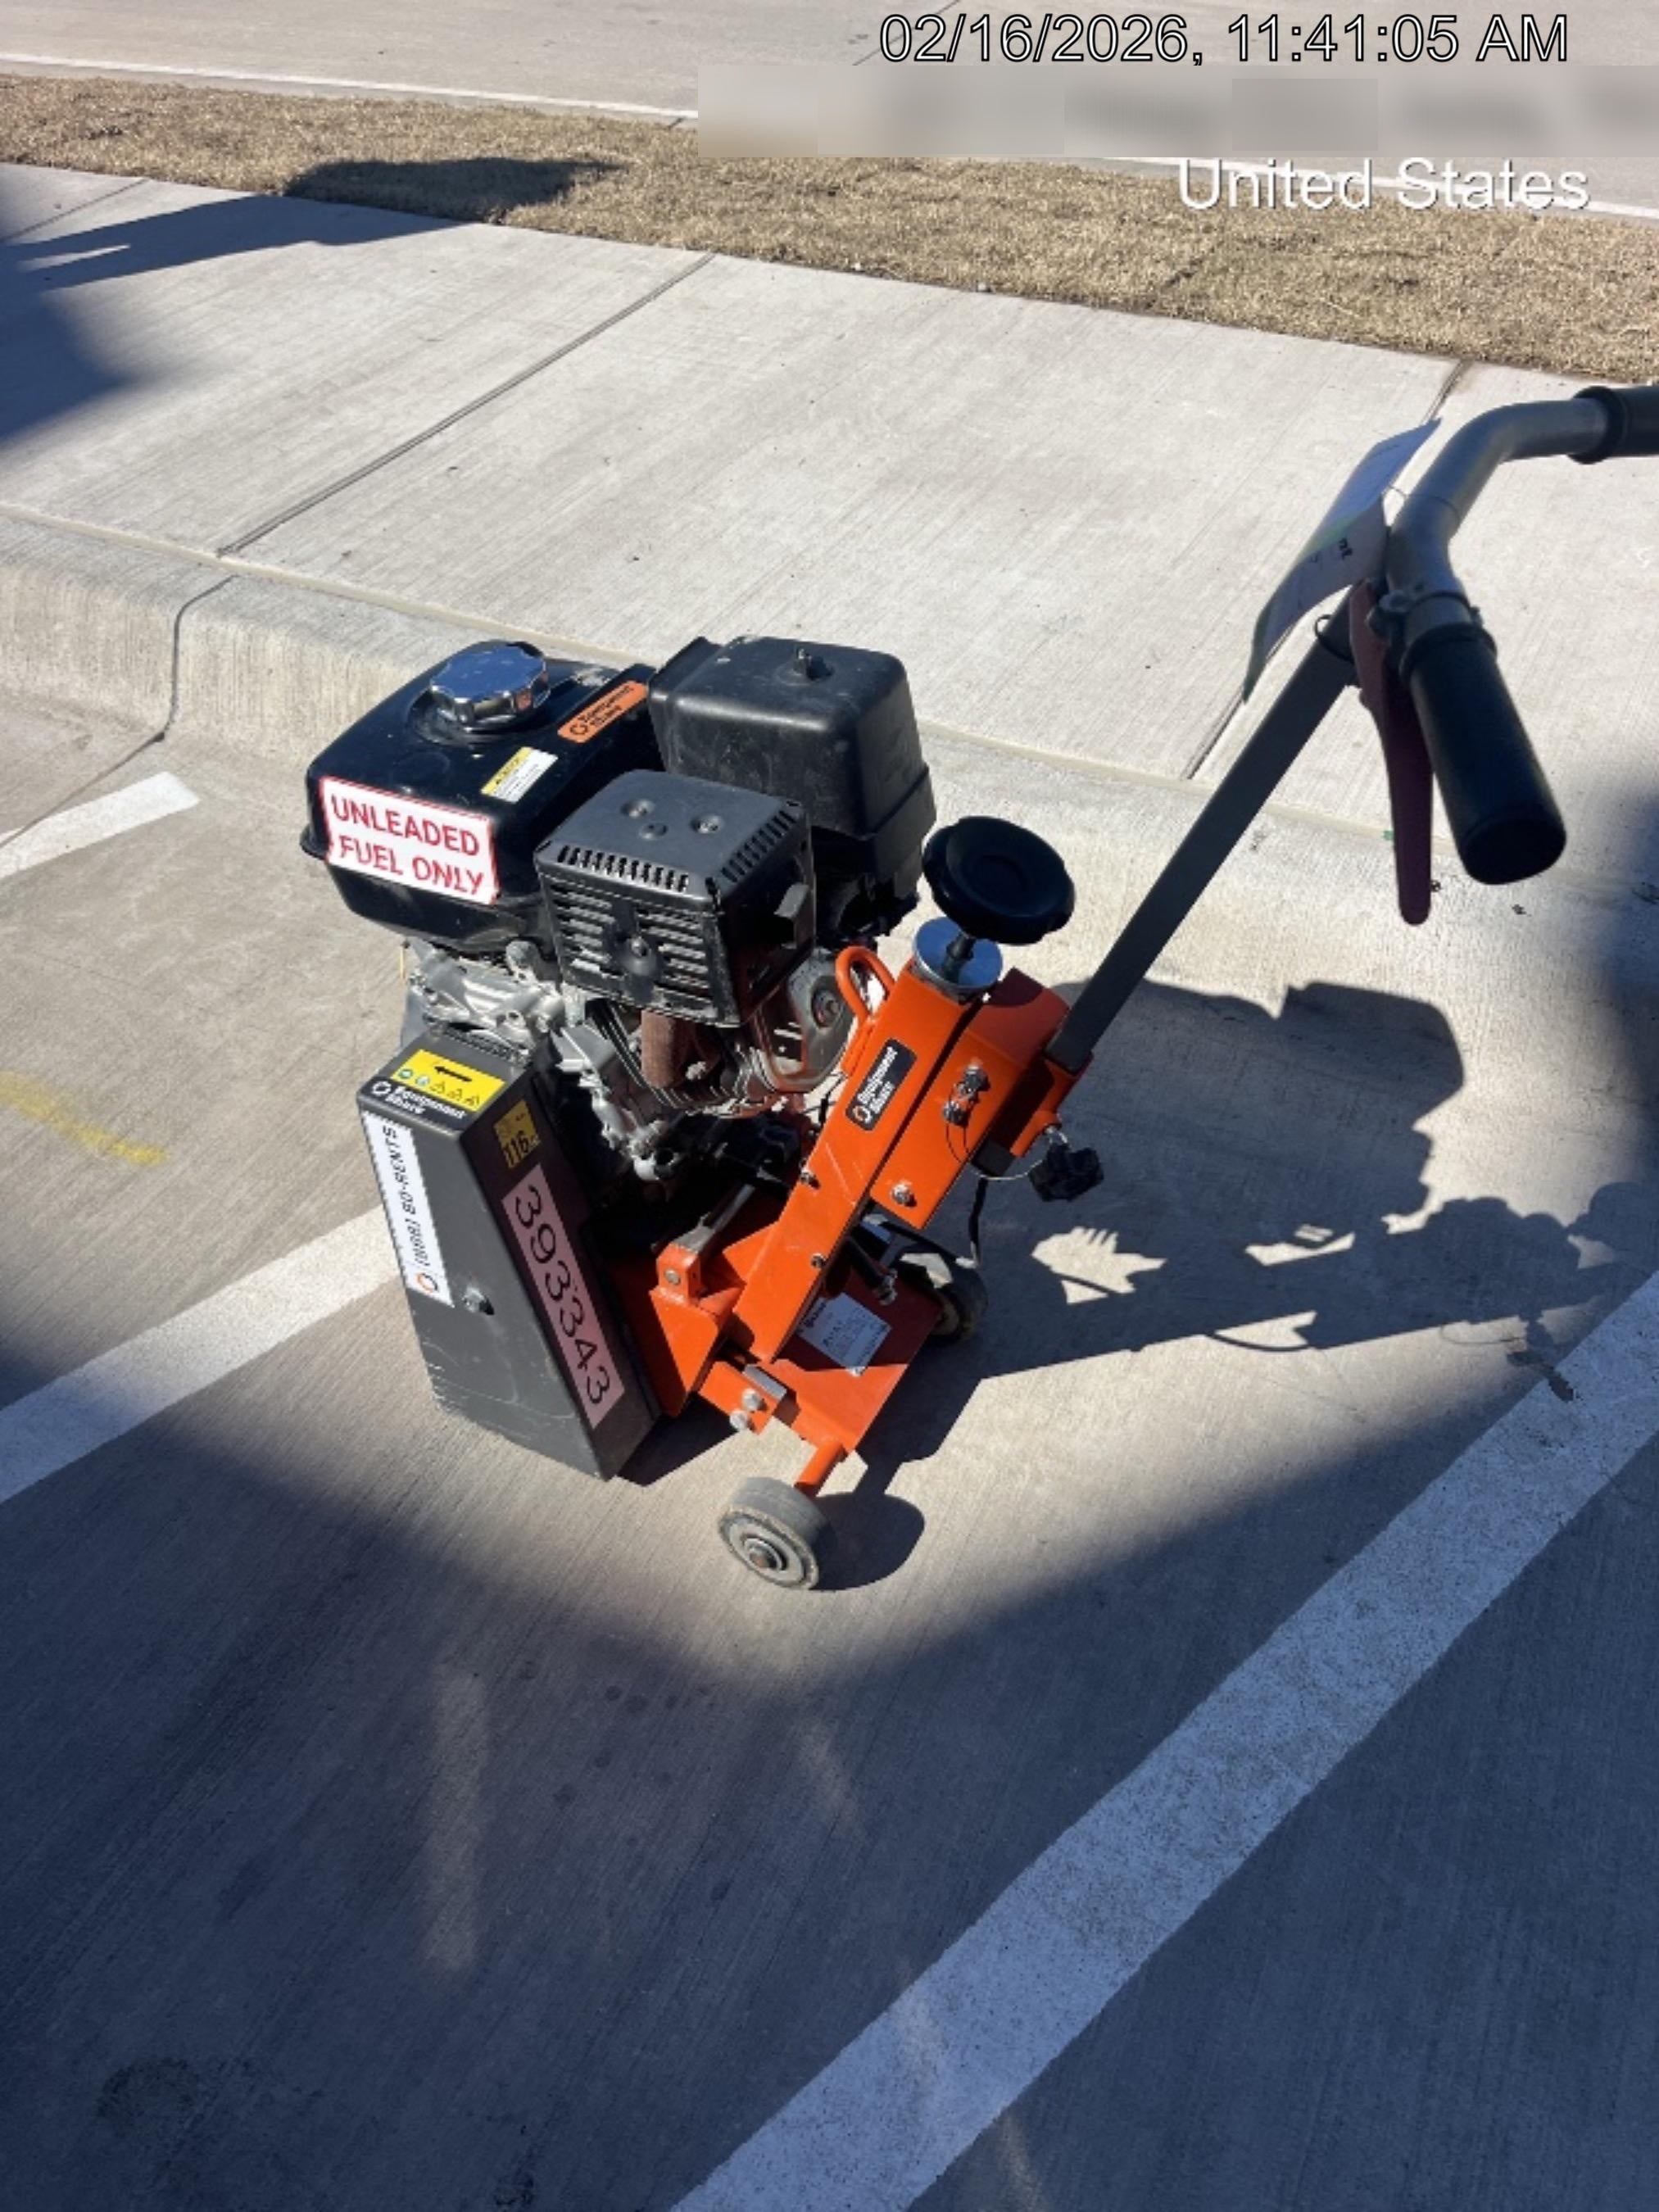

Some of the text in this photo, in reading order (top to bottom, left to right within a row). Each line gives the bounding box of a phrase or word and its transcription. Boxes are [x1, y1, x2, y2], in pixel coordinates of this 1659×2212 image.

[331, 793, 480, 856] UNLEADED
[338, 834, 484, 895] FUEL ONLY
[515, 1185, 610, 1404] 393343
